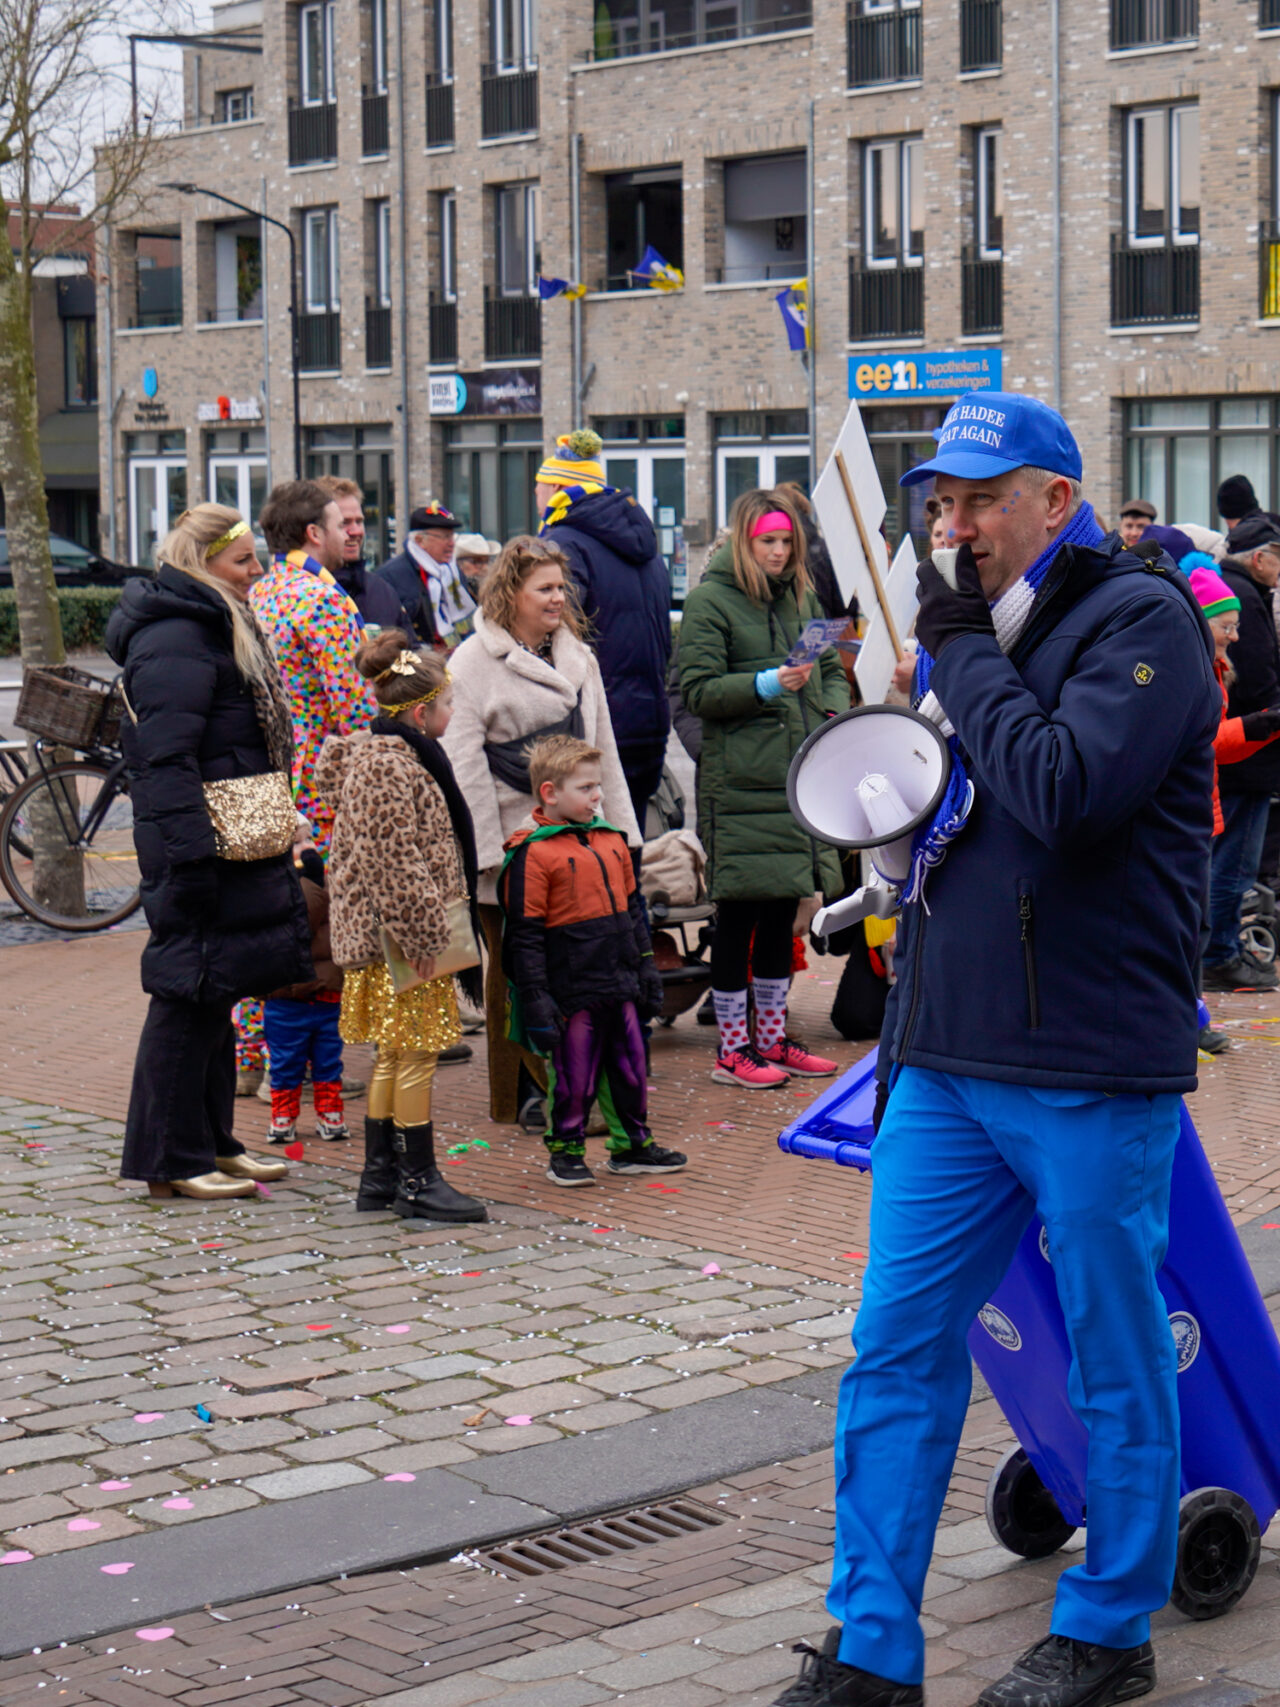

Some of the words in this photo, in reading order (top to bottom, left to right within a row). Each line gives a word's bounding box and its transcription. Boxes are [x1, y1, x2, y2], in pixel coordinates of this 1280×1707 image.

[925, 361, 980, 377] hypotheken
[982, 358, 989, 371] &
[925, 376, 991, 391] verzekeringen
[959, 405, 1006, 428] HADEE
[958, 424, 1003, 449] AGAIN
